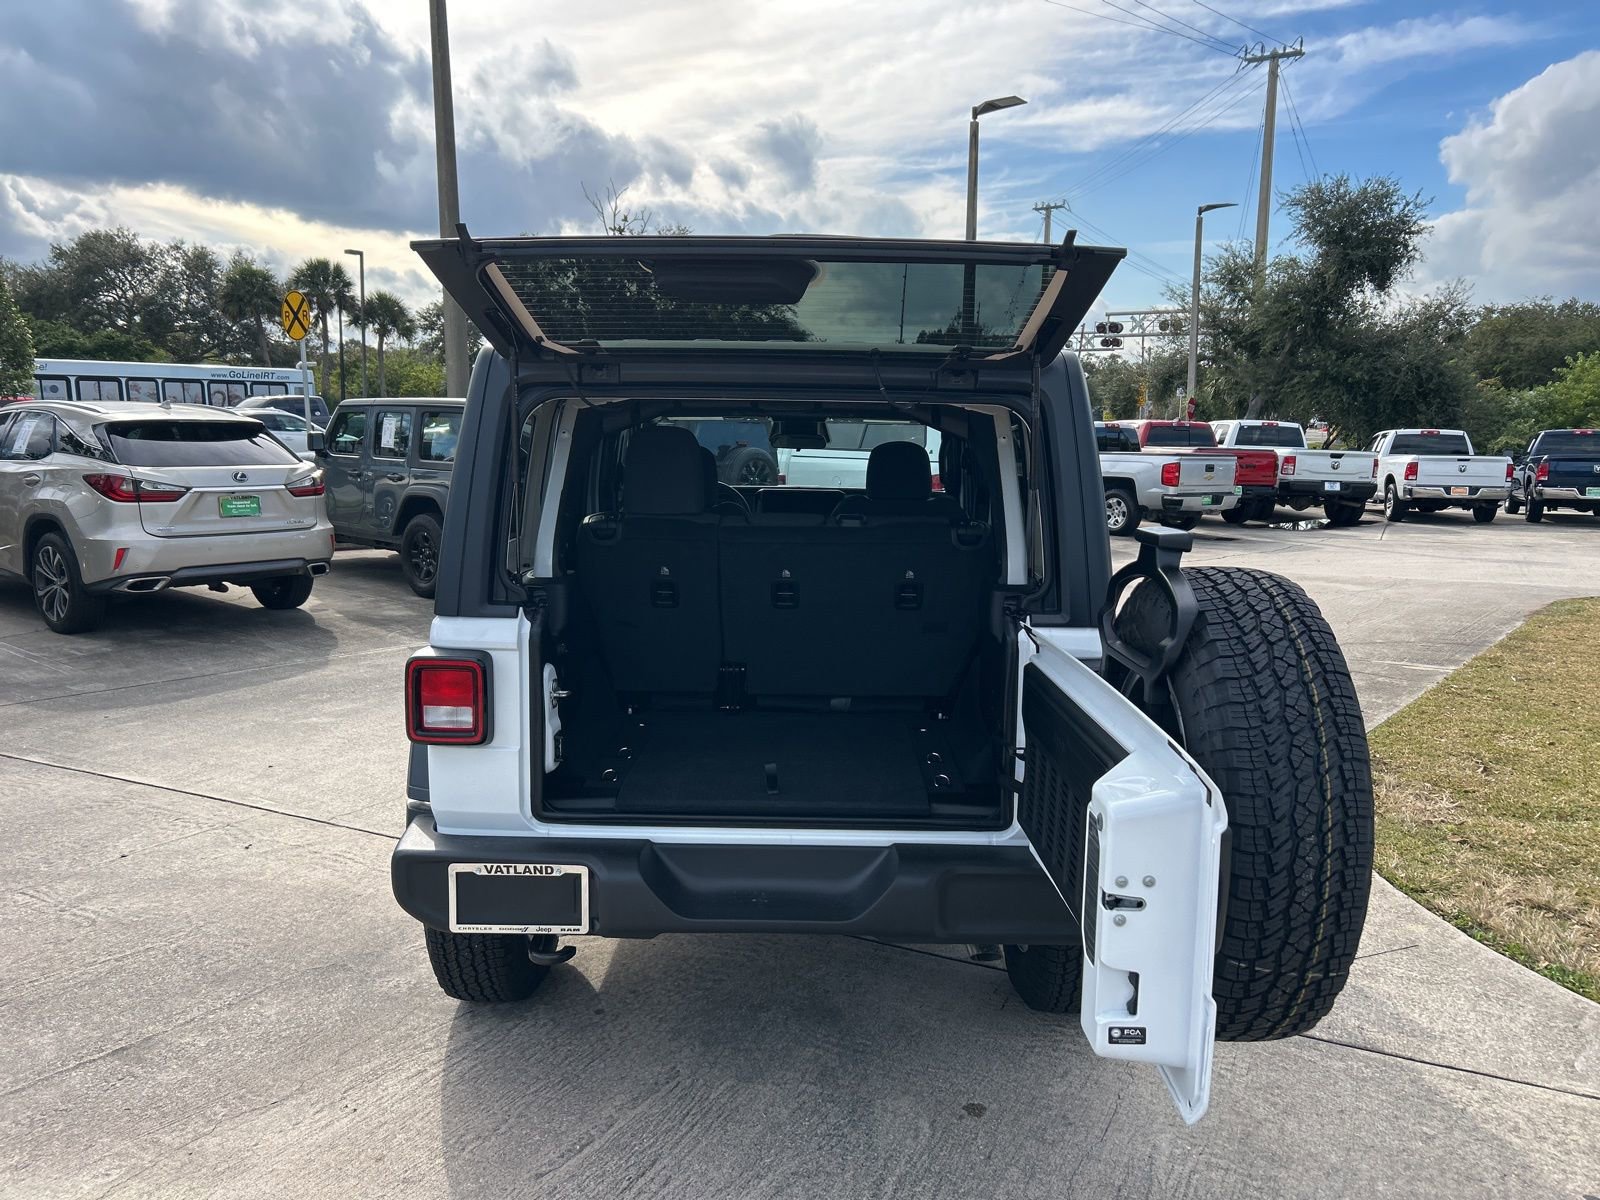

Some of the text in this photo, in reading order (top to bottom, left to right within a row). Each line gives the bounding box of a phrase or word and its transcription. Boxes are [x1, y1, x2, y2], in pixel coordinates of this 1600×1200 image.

[285, 310, 308, 321] R R
[210, 370, 290, 380] www.GoLineIRT.com
[483, 864, 554, 875] VATLAND
